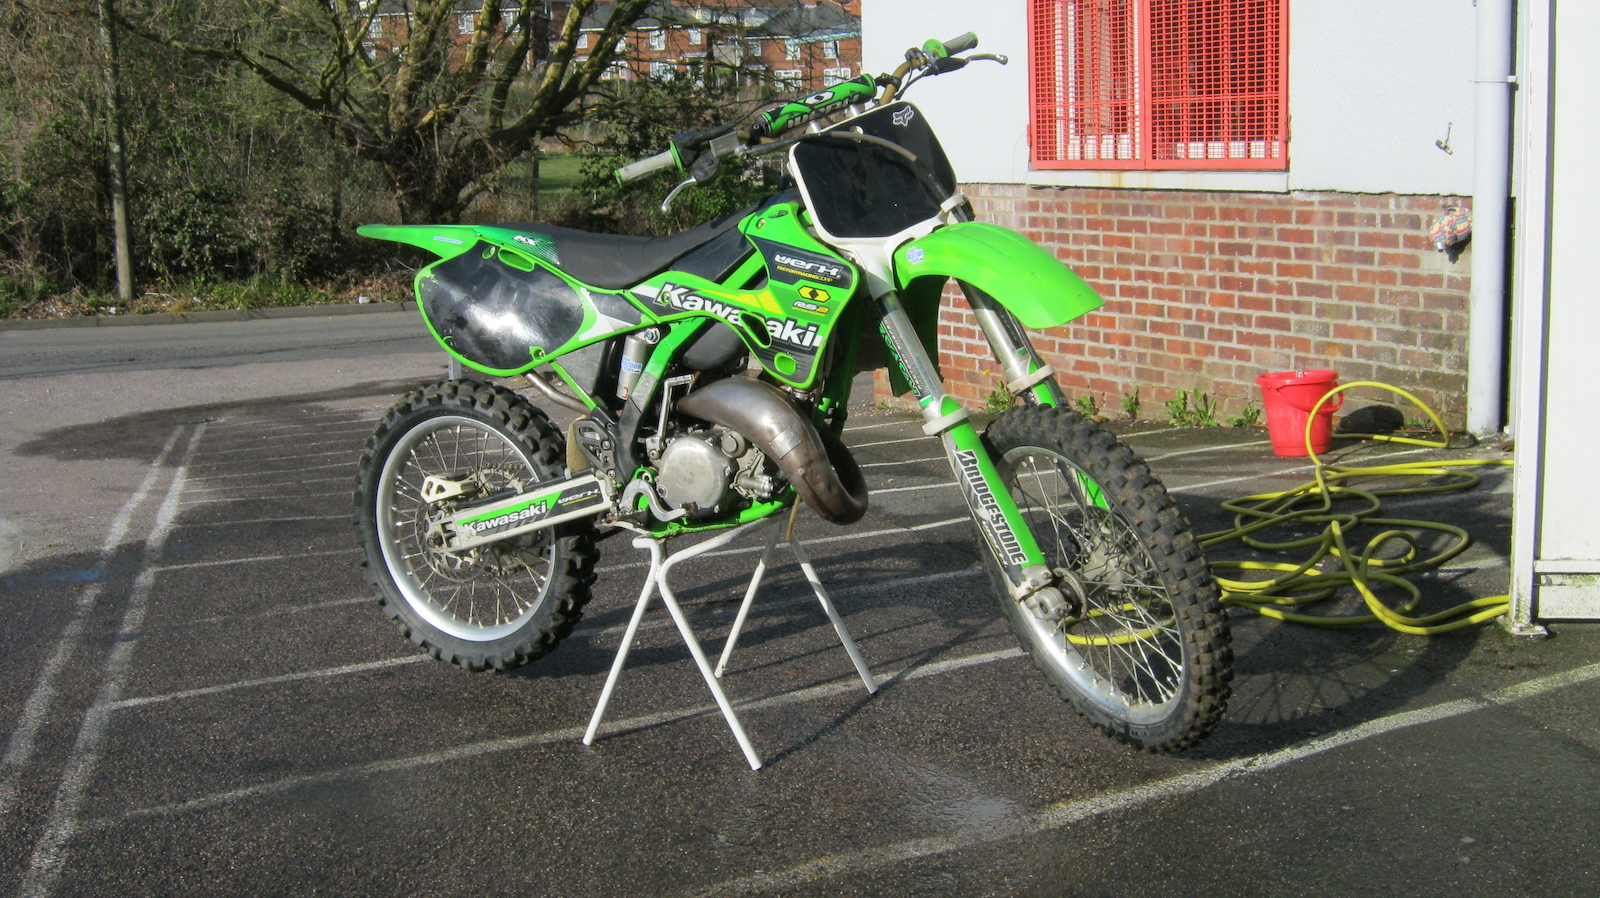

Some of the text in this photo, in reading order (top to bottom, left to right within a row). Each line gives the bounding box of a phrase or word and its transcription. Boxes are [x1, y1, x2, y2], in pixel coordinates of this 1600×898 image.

[655, 282, 817, 348] Kawaaki
[463, 501, 547, 533] Kawasaki
[952, 449, 1029, 565] BRIDGESTONE
